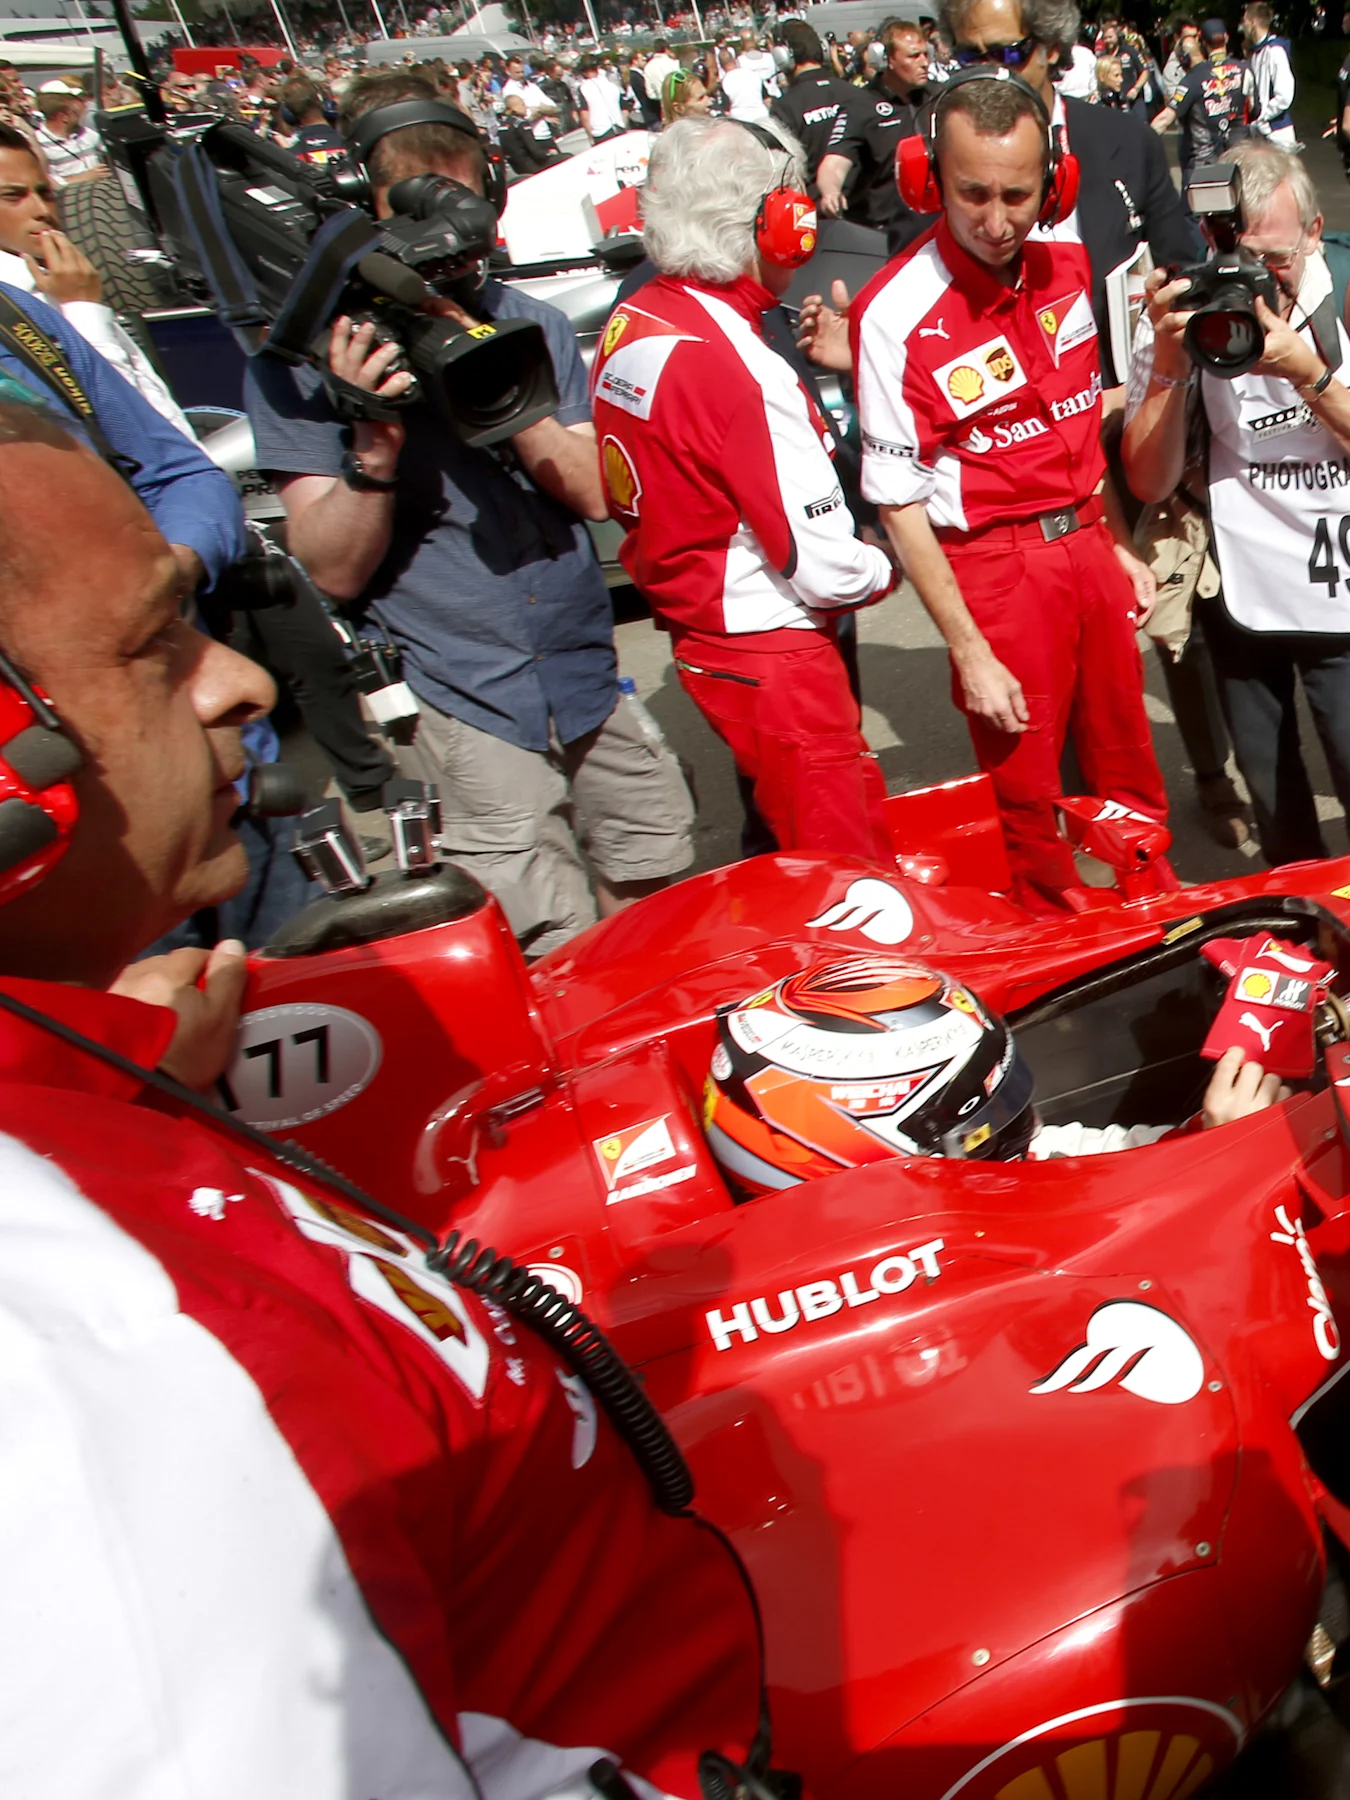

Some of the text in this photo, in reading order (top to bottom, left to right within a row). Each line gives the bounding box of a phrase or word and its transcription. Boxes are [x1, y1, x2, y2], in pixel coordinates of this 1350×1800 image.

[987, 354, 1015, 380] ups
[830, 1080, 911, 1101] WEICHAI
[705, 1238, 945, 1352] HUBLOT
[1290, 1216, 1341, 1360] Claro
